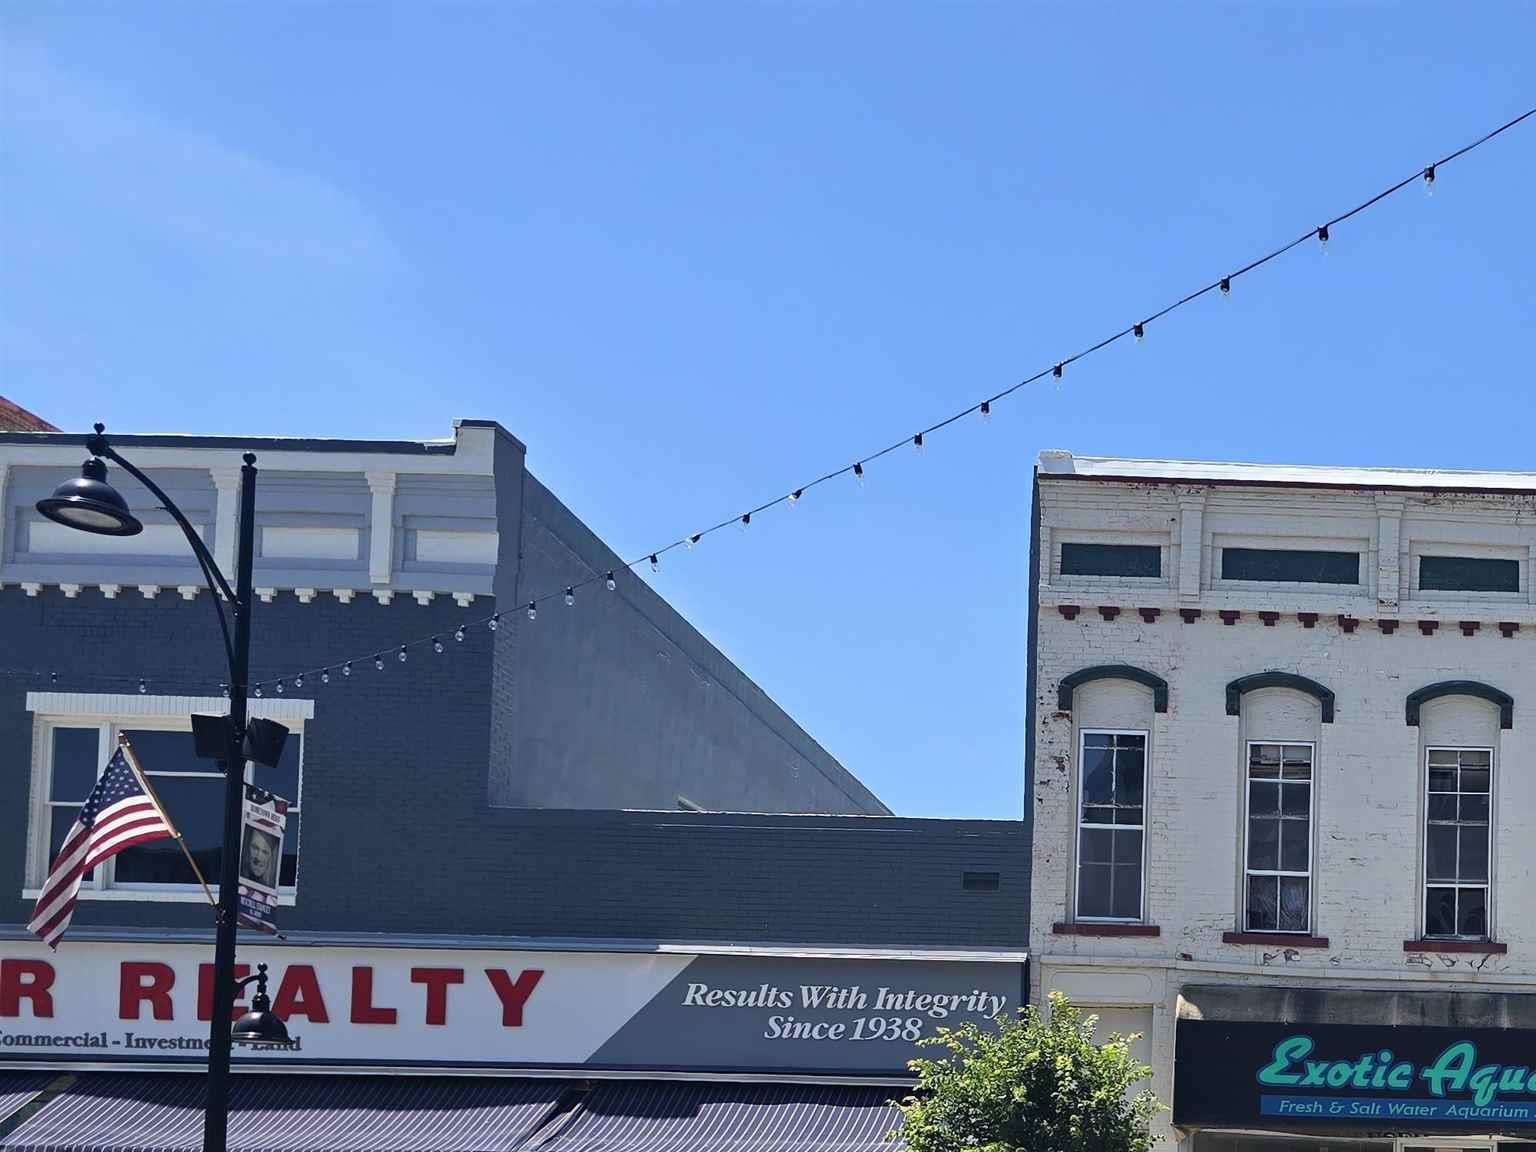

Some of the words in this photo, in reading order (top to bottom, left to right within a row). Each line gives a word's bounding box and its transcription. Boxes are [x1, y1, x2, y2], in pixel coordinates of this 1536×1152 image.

[0, 959, 55, 1018] R
[118, 961, 545, 1027] REALTY
[682, 983, 793, 1009] Results
[800, 985, 866, 1011] With
[873, 987, 1007, 1019] Integrity
[0, 1031, 108, 1048] ommercial
[125, 1032, 234, 1051] Investme
[764, 1016, 845, 1040] Since
[849, 1017, 924, 1042] 1938
[1256, 1035, 1414, 1091] Exotic
[1279, 1100, 1323, 1114] Fresh
[1329, 1101, 1345, 1114] &
[1350, 1102, 1381, 1115] Salt
[1388, 1103, 1438, 1117] Water
[1446, 1104, 1529, 1120] Aquarium
